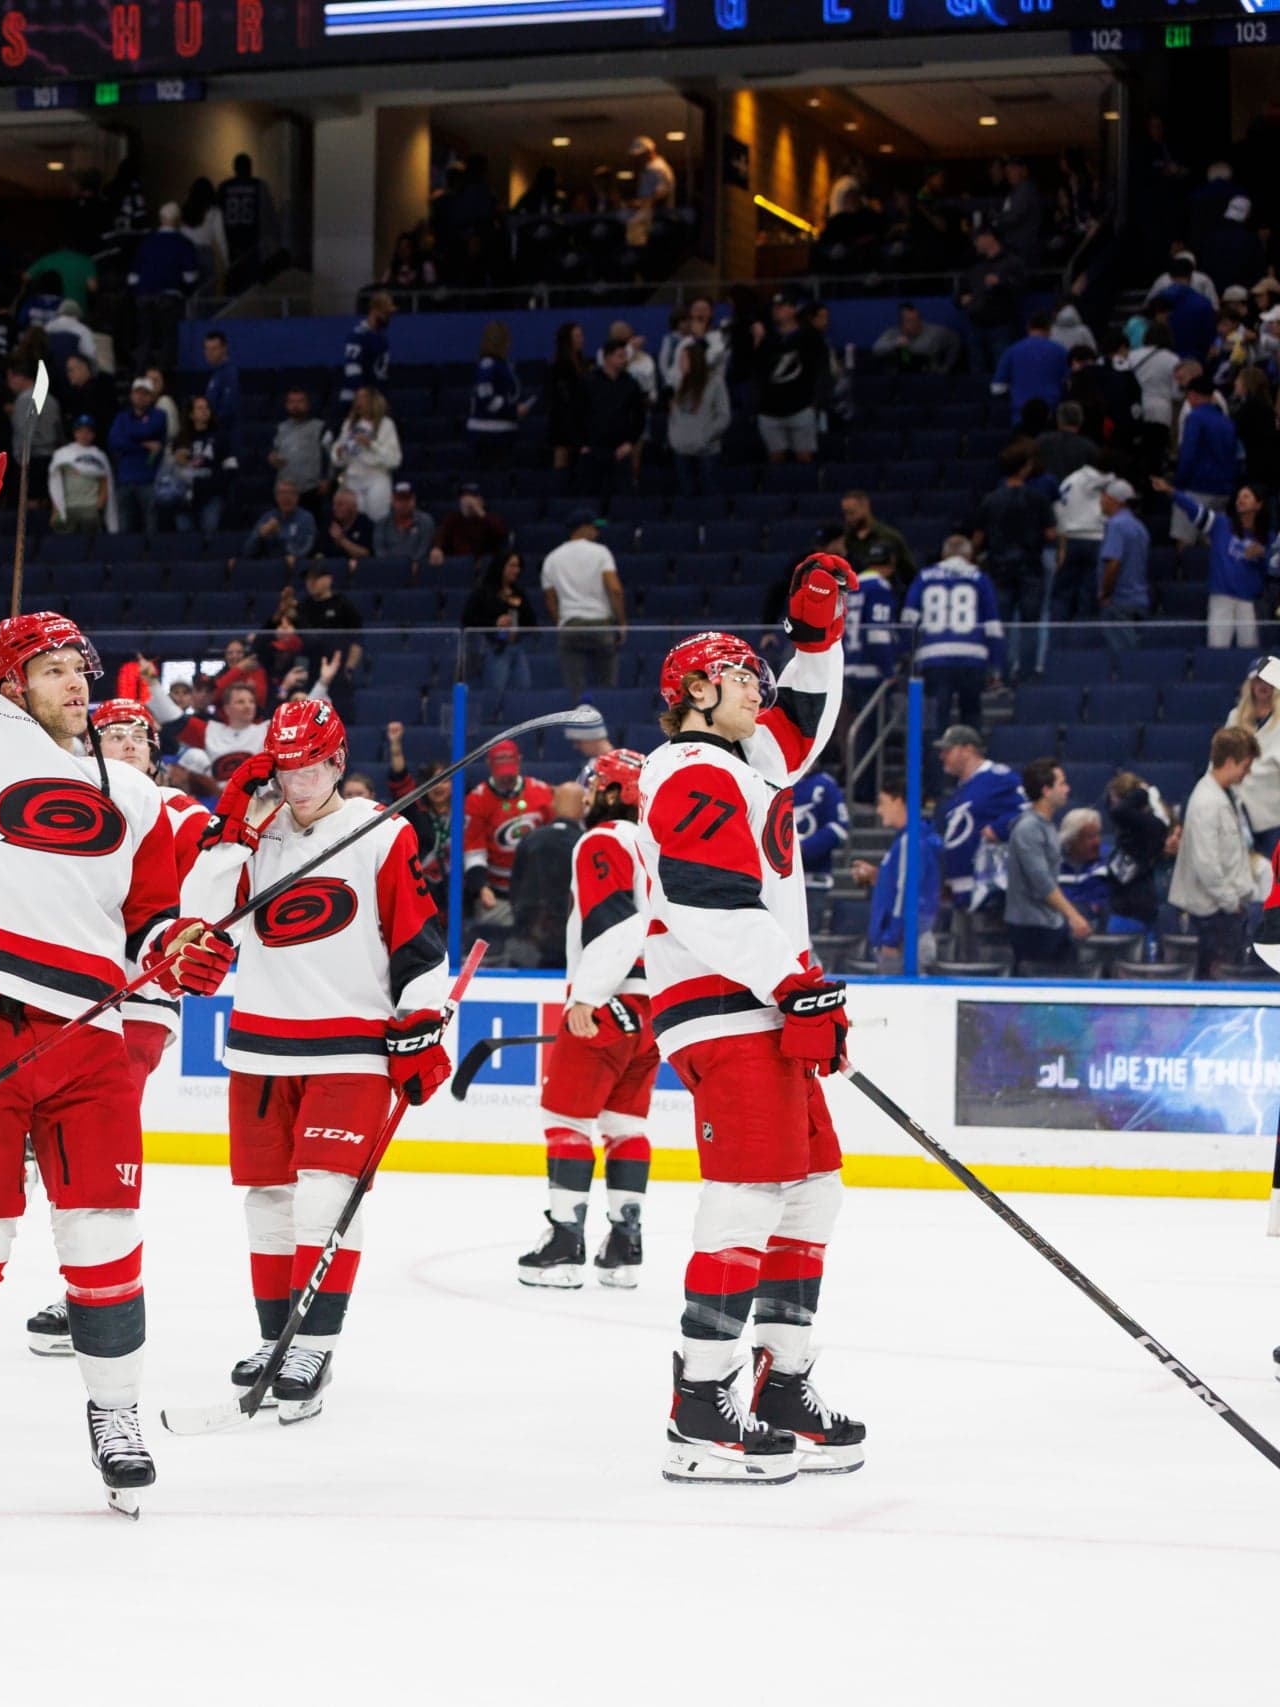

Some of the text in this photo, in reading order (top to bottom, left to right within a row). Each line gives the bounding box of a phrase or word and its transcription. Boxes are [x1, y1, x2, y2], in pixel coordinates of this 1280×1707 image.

[1090, 30, 1123, 51] 102
[1165, 25, 1191, 48] EXIT
[1235, 22, 1268, 43] 103
[33, 86, 59, 107] 101
[155, 80, 185, 101] 102
[921, 584, 978, 635] 88
[44, 623, 72, 633] CCM
[673, 790, 737, 841] 77
[592, 851, 610, 881] 5
[386, 1028, 442, 1053] CCM
[303, 1127, 365, 1145] CCM
[297, 1229, 343, 1318] CCM
[1135, 1334, 1231, 1414] CCM
